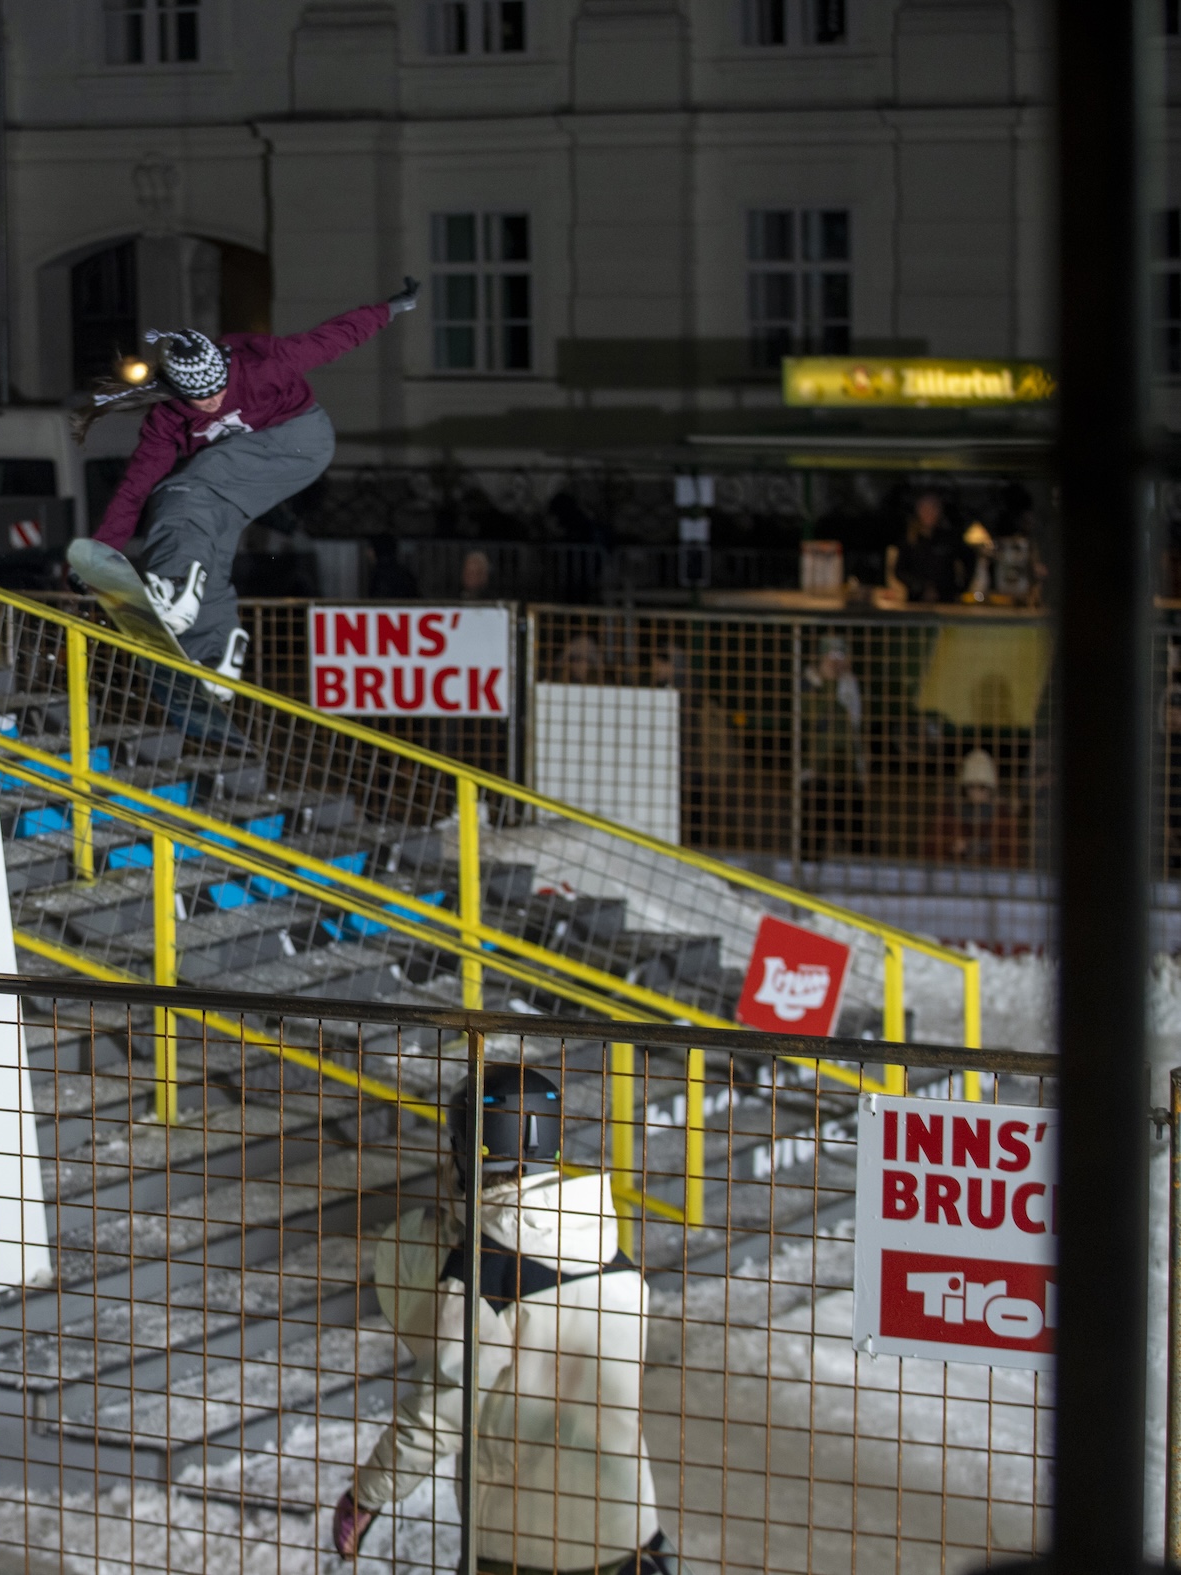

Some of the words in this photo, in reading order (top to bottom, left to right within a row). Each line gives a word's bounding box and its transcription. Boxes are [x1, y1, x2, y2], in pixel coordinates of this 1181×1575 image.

[315, 613, 462, 658] INNS'
[316, 666, 503, 711] BRUCK
[883, 1110, 1047, 1173] INNS'
[882, 1169, 1058, 1235] BRUC
